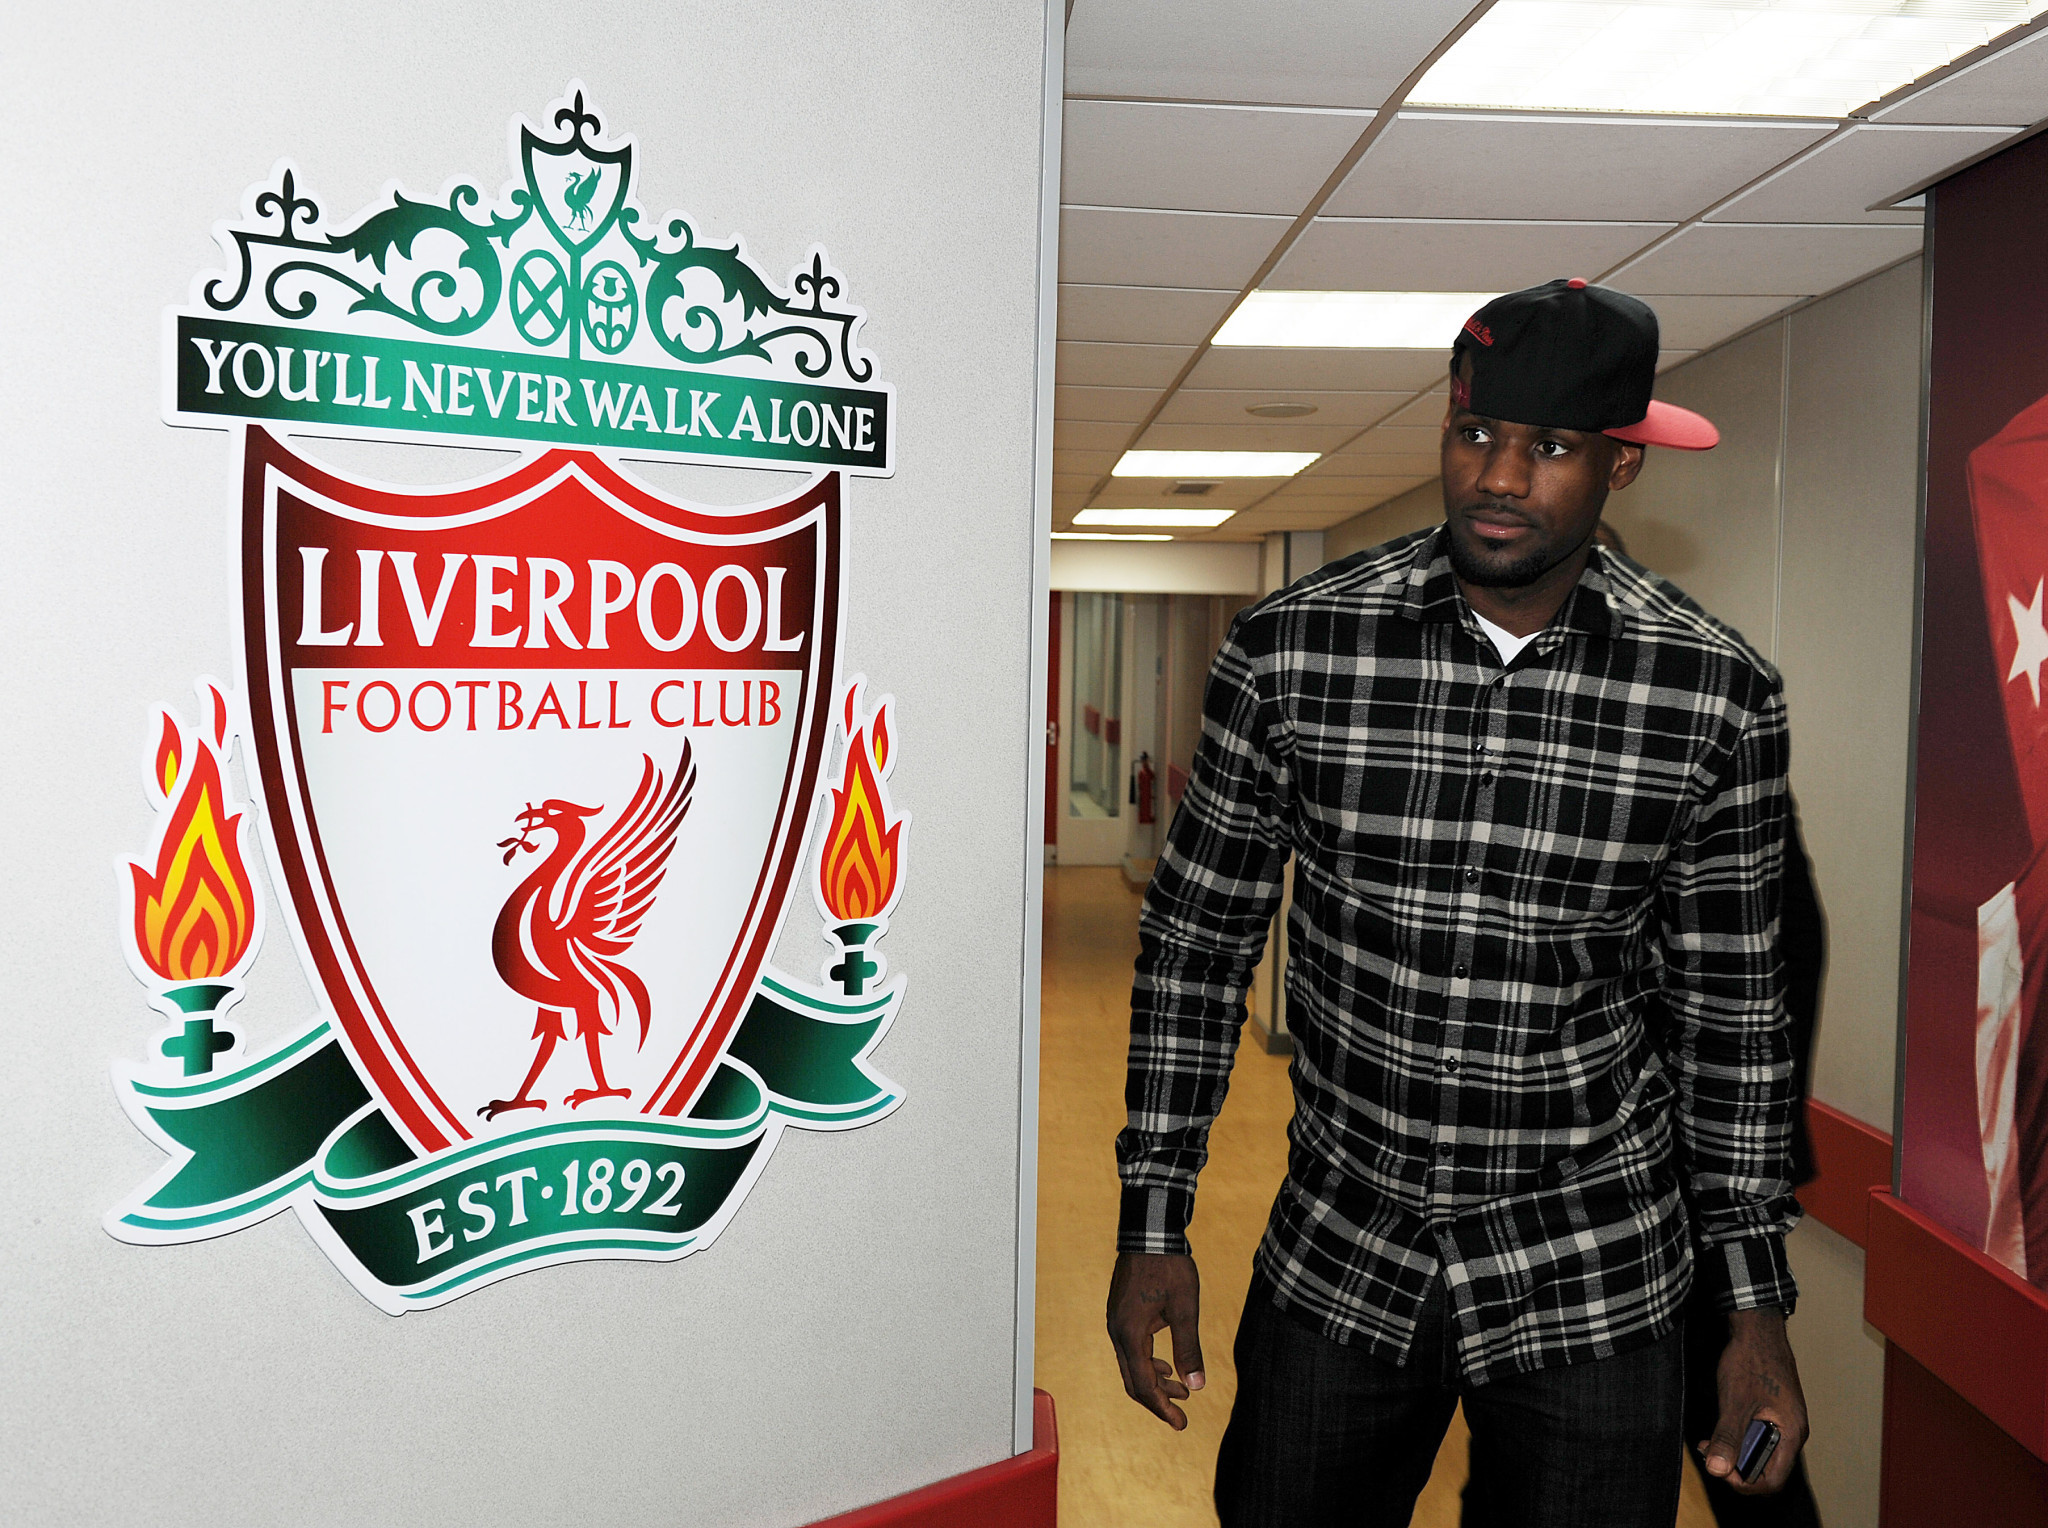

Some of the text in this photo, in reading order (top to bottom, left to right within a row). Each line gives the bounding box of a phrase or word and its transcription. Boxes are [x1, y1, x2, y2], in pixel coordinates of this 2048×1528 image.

[190, 337, 876, 452] YOU'LL NEVER WALK ALONE
[296, 546, 805, 653] LIVERPOOL
[321, 680, 782, 734] FOOTBALL CLUB
